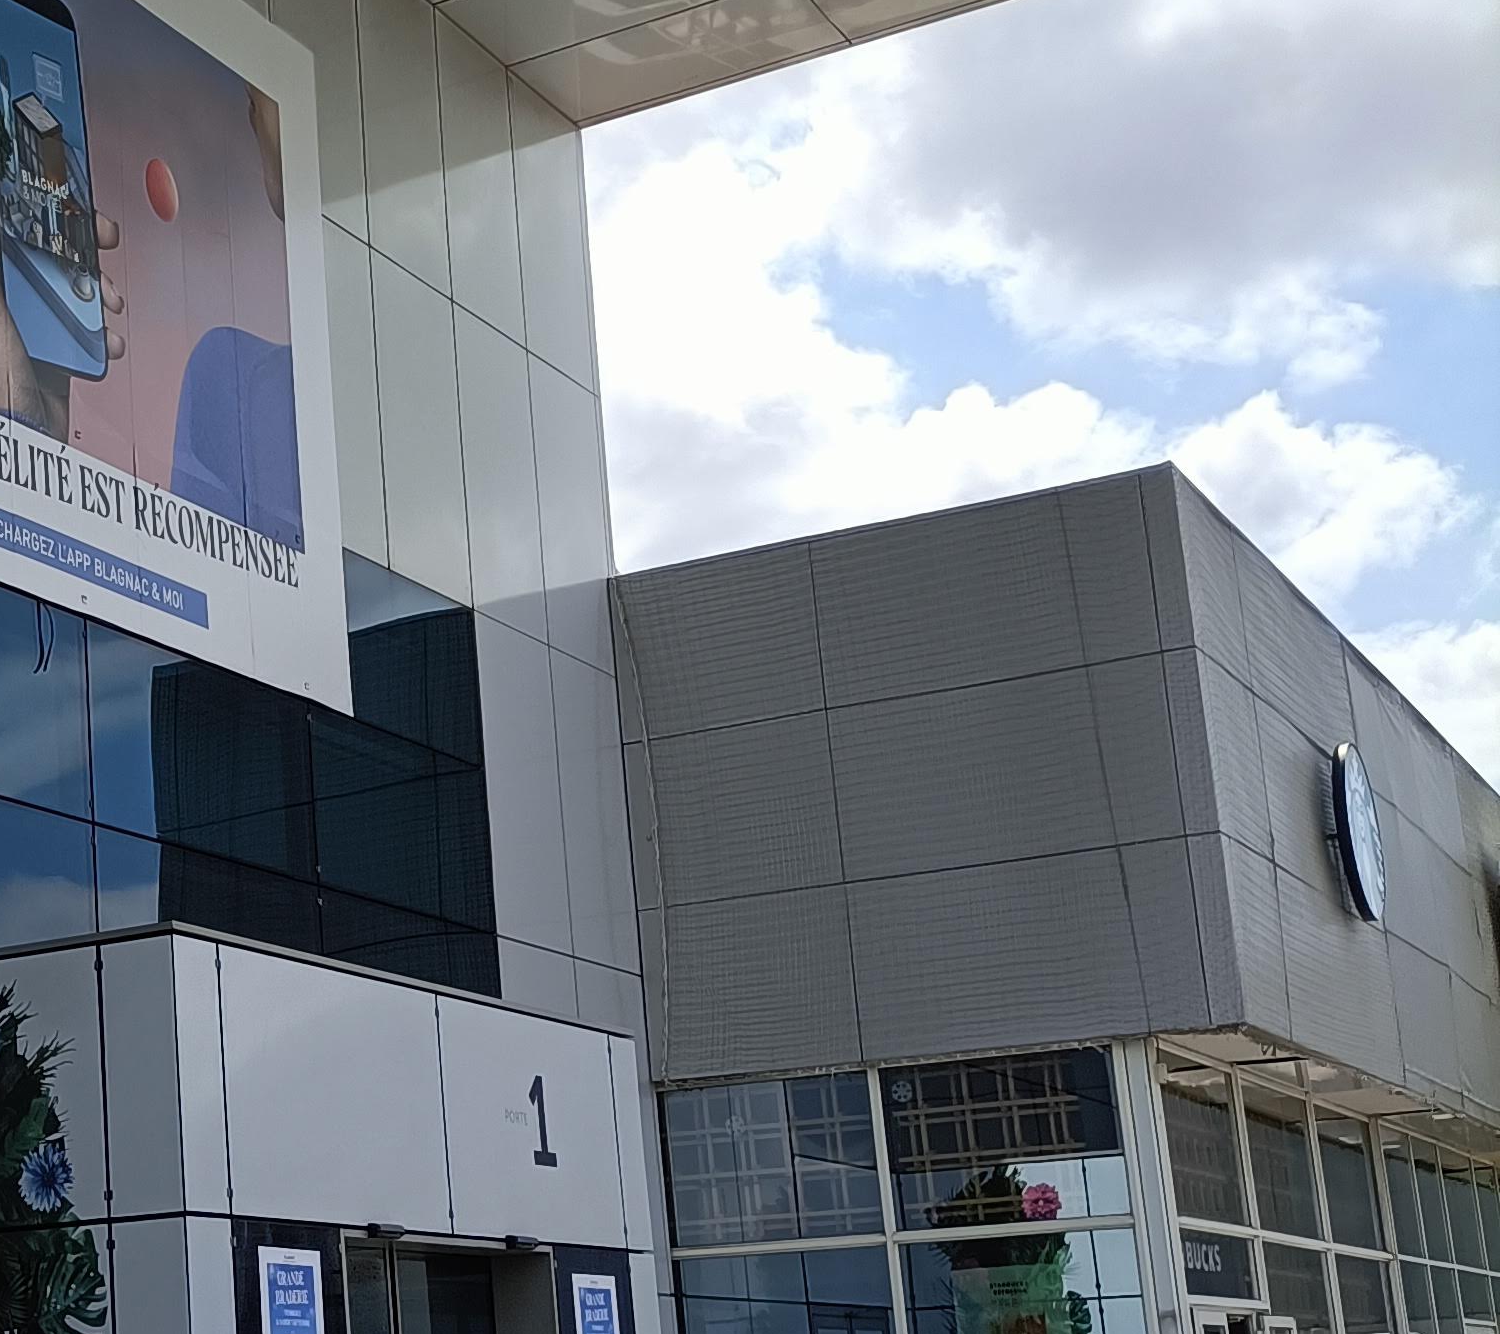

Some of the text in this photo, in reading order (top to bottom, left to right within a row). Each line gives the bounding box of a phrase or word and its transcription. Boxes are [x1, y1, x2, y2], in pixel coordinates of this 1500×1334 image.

[22, 170, 68, 199] BLAGNAC
[79, 464, 125, 524] EST
[132, 483, 299, 588] RÉCOMPENSÉE
[58, 543, 91, 571] L'APP
[95, 557, 149, 596] BLAGNAC
[151, 583, 161, 602] &
[163, 587, 184, 610] MOI
[529, 1075, 557, 1168] 1
